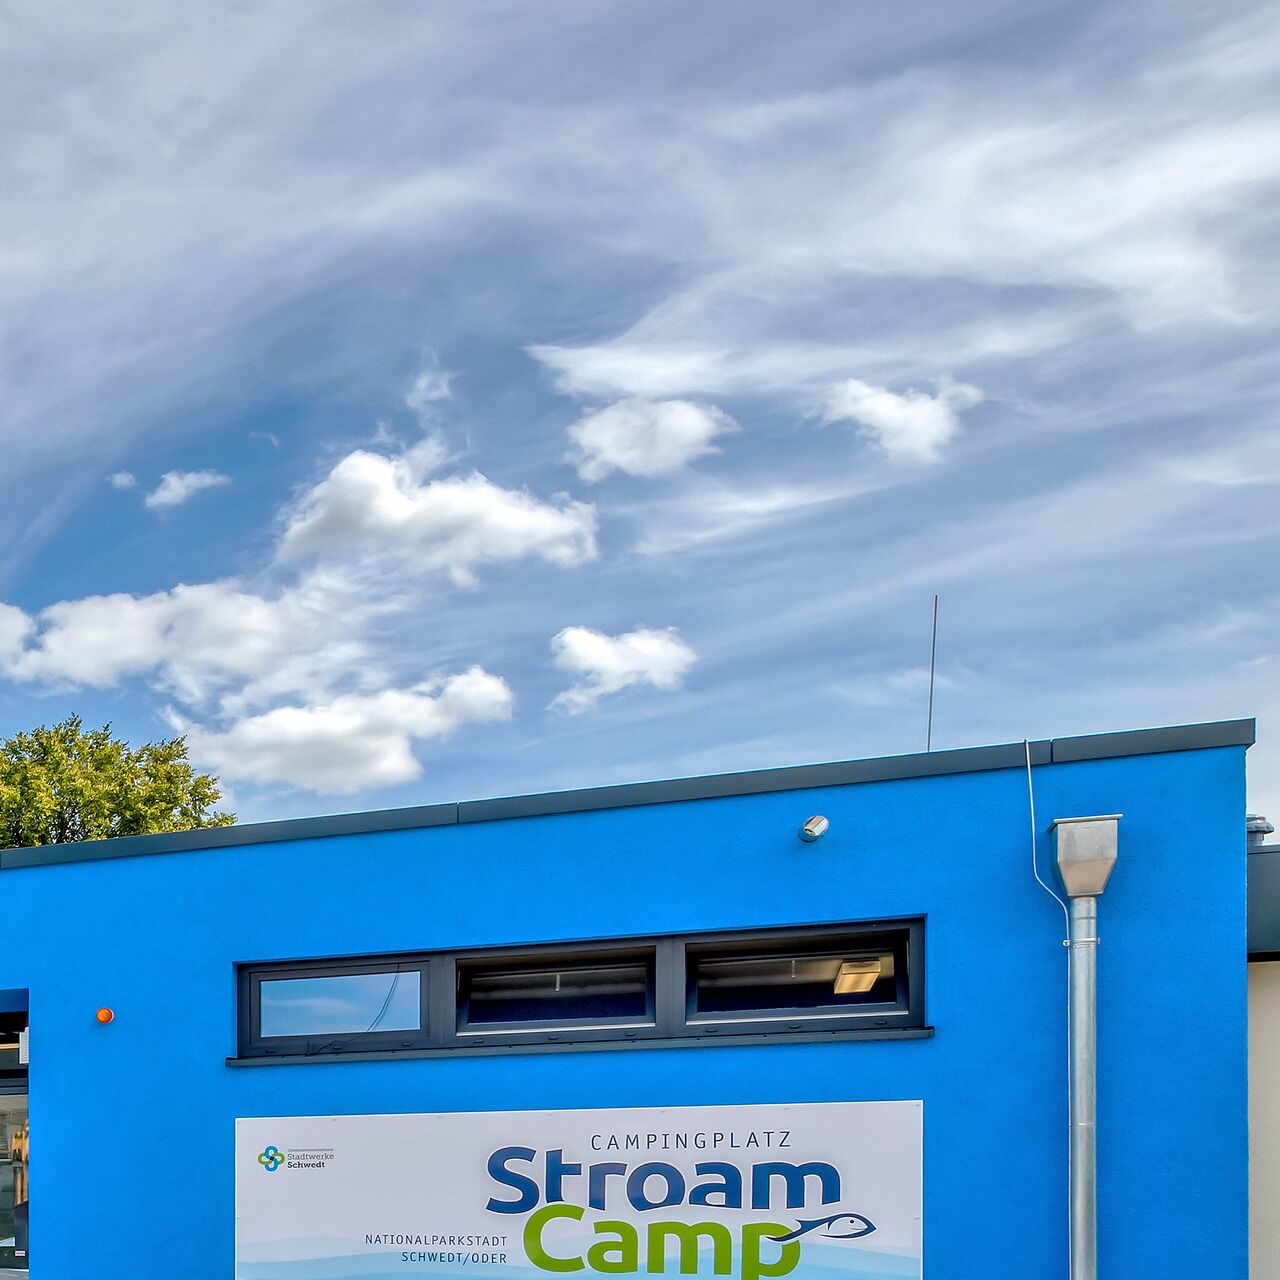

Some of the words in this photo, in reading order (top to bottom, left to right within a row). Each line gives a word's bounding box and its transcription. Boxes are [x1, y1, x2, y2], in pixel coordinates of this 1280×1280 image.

[591, 1131, 791, 1151] CAMPINGPLATZ
[287, 1152, 335, 1161] Stadtwerke
[287, 1161, 326, 1169] Schwedt
[486, 1146, 841, 1214] Stroam
[365, 1234, 508, 1247] NATIONALPARKSTADT
[402, 1251, 507, 1266] SCHWEDT/ODER
